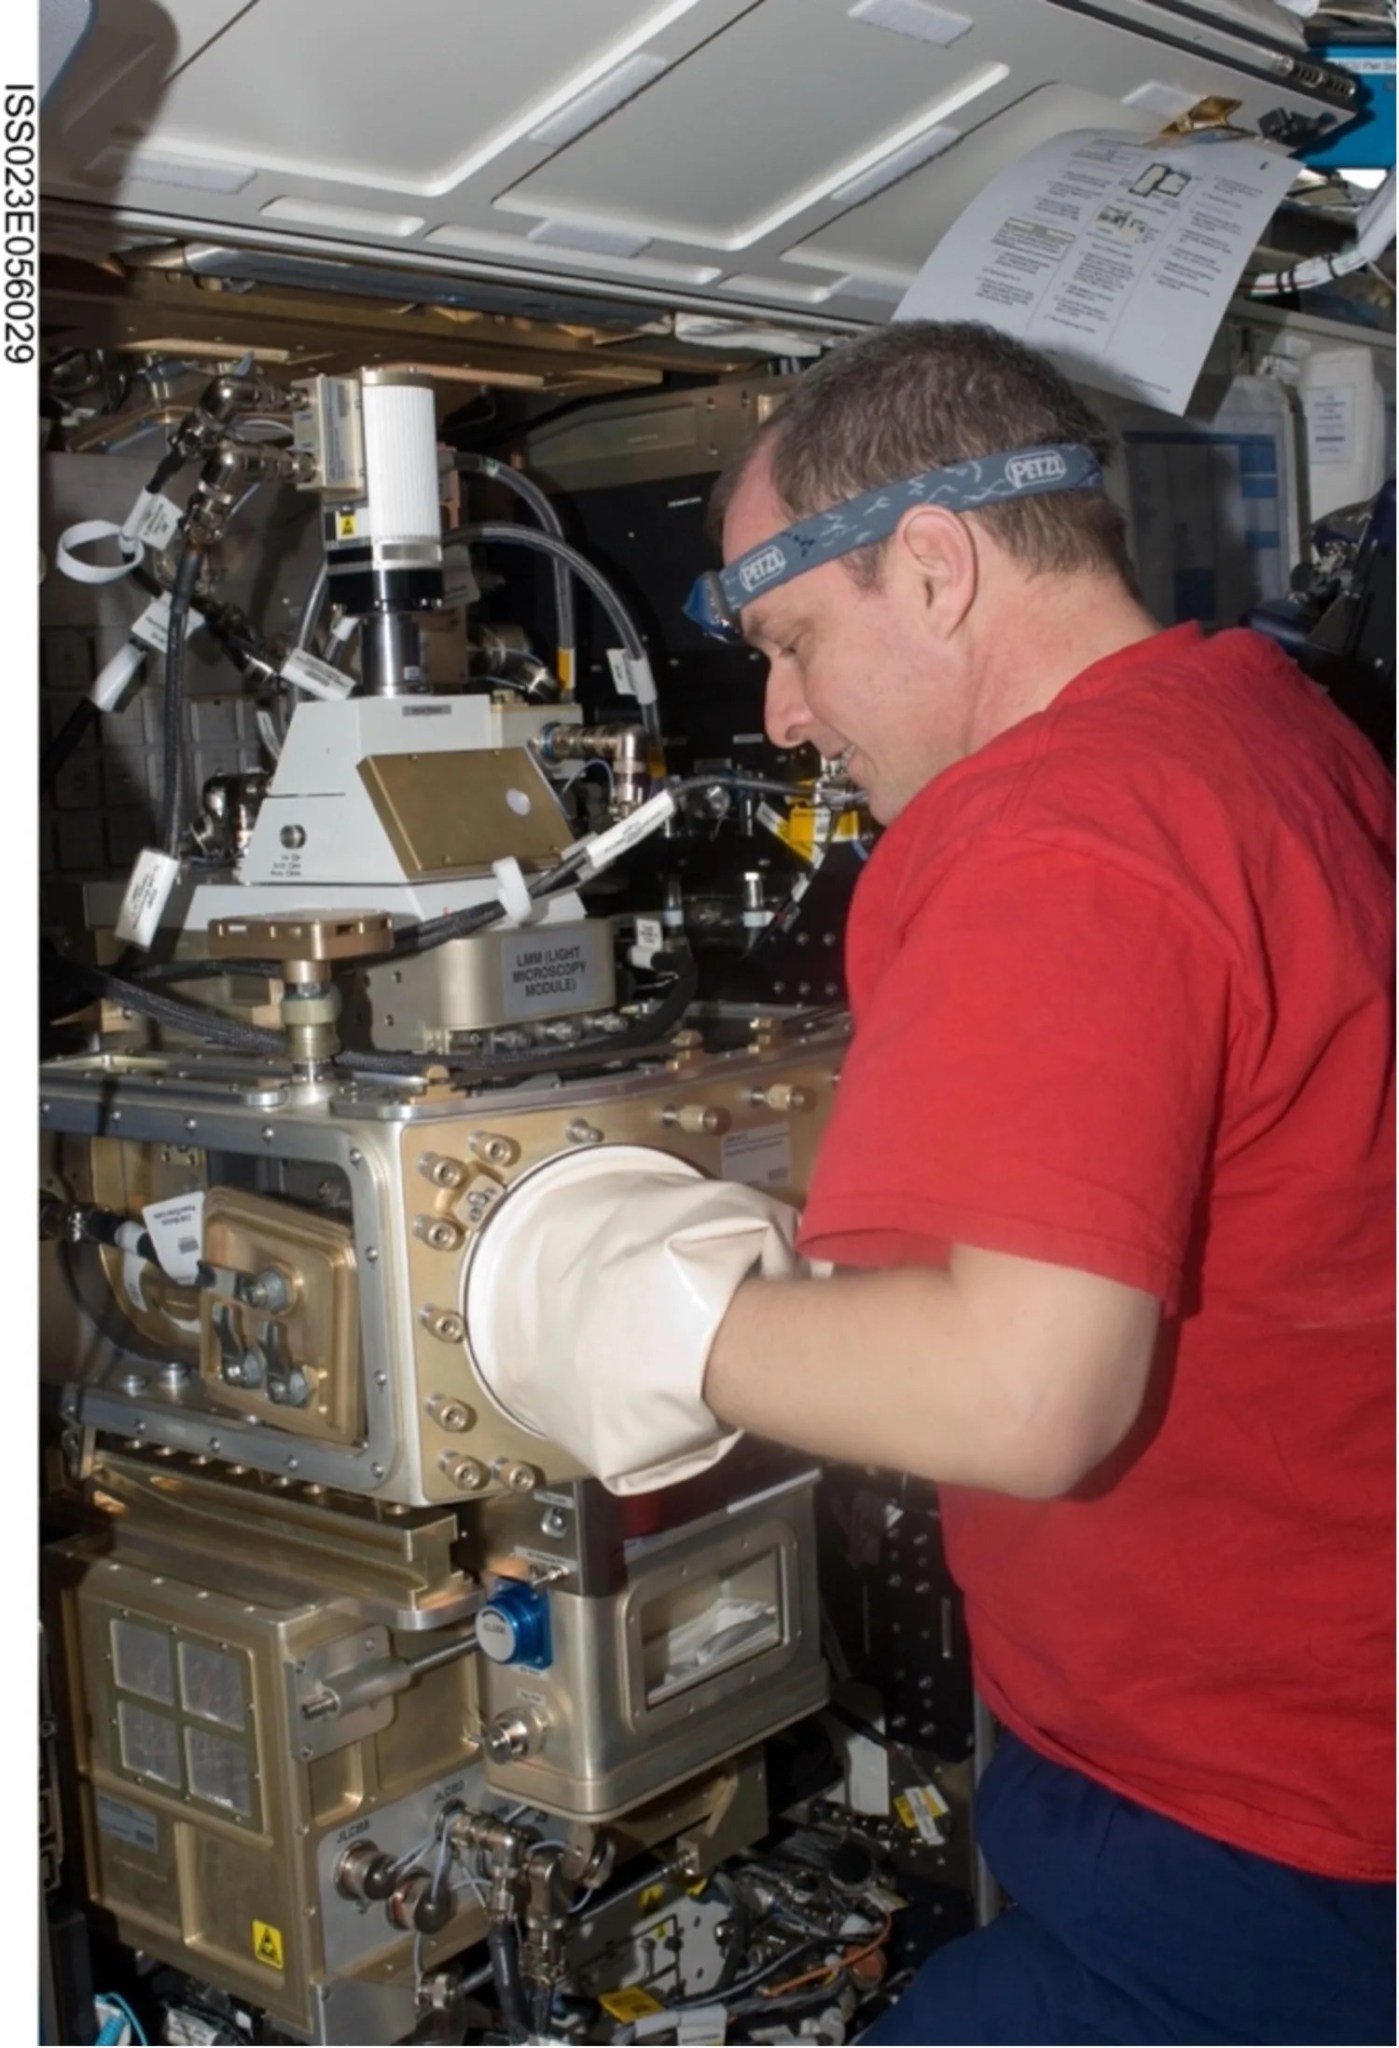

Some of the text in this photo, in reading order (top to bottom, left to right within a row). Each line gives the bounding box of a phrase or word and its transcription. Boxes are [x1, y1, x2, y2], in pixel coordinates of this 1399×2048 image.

[516, 946, 581, 968] LMM (LIGHT
[512, 961, 587, 983] MICROSCOPY
